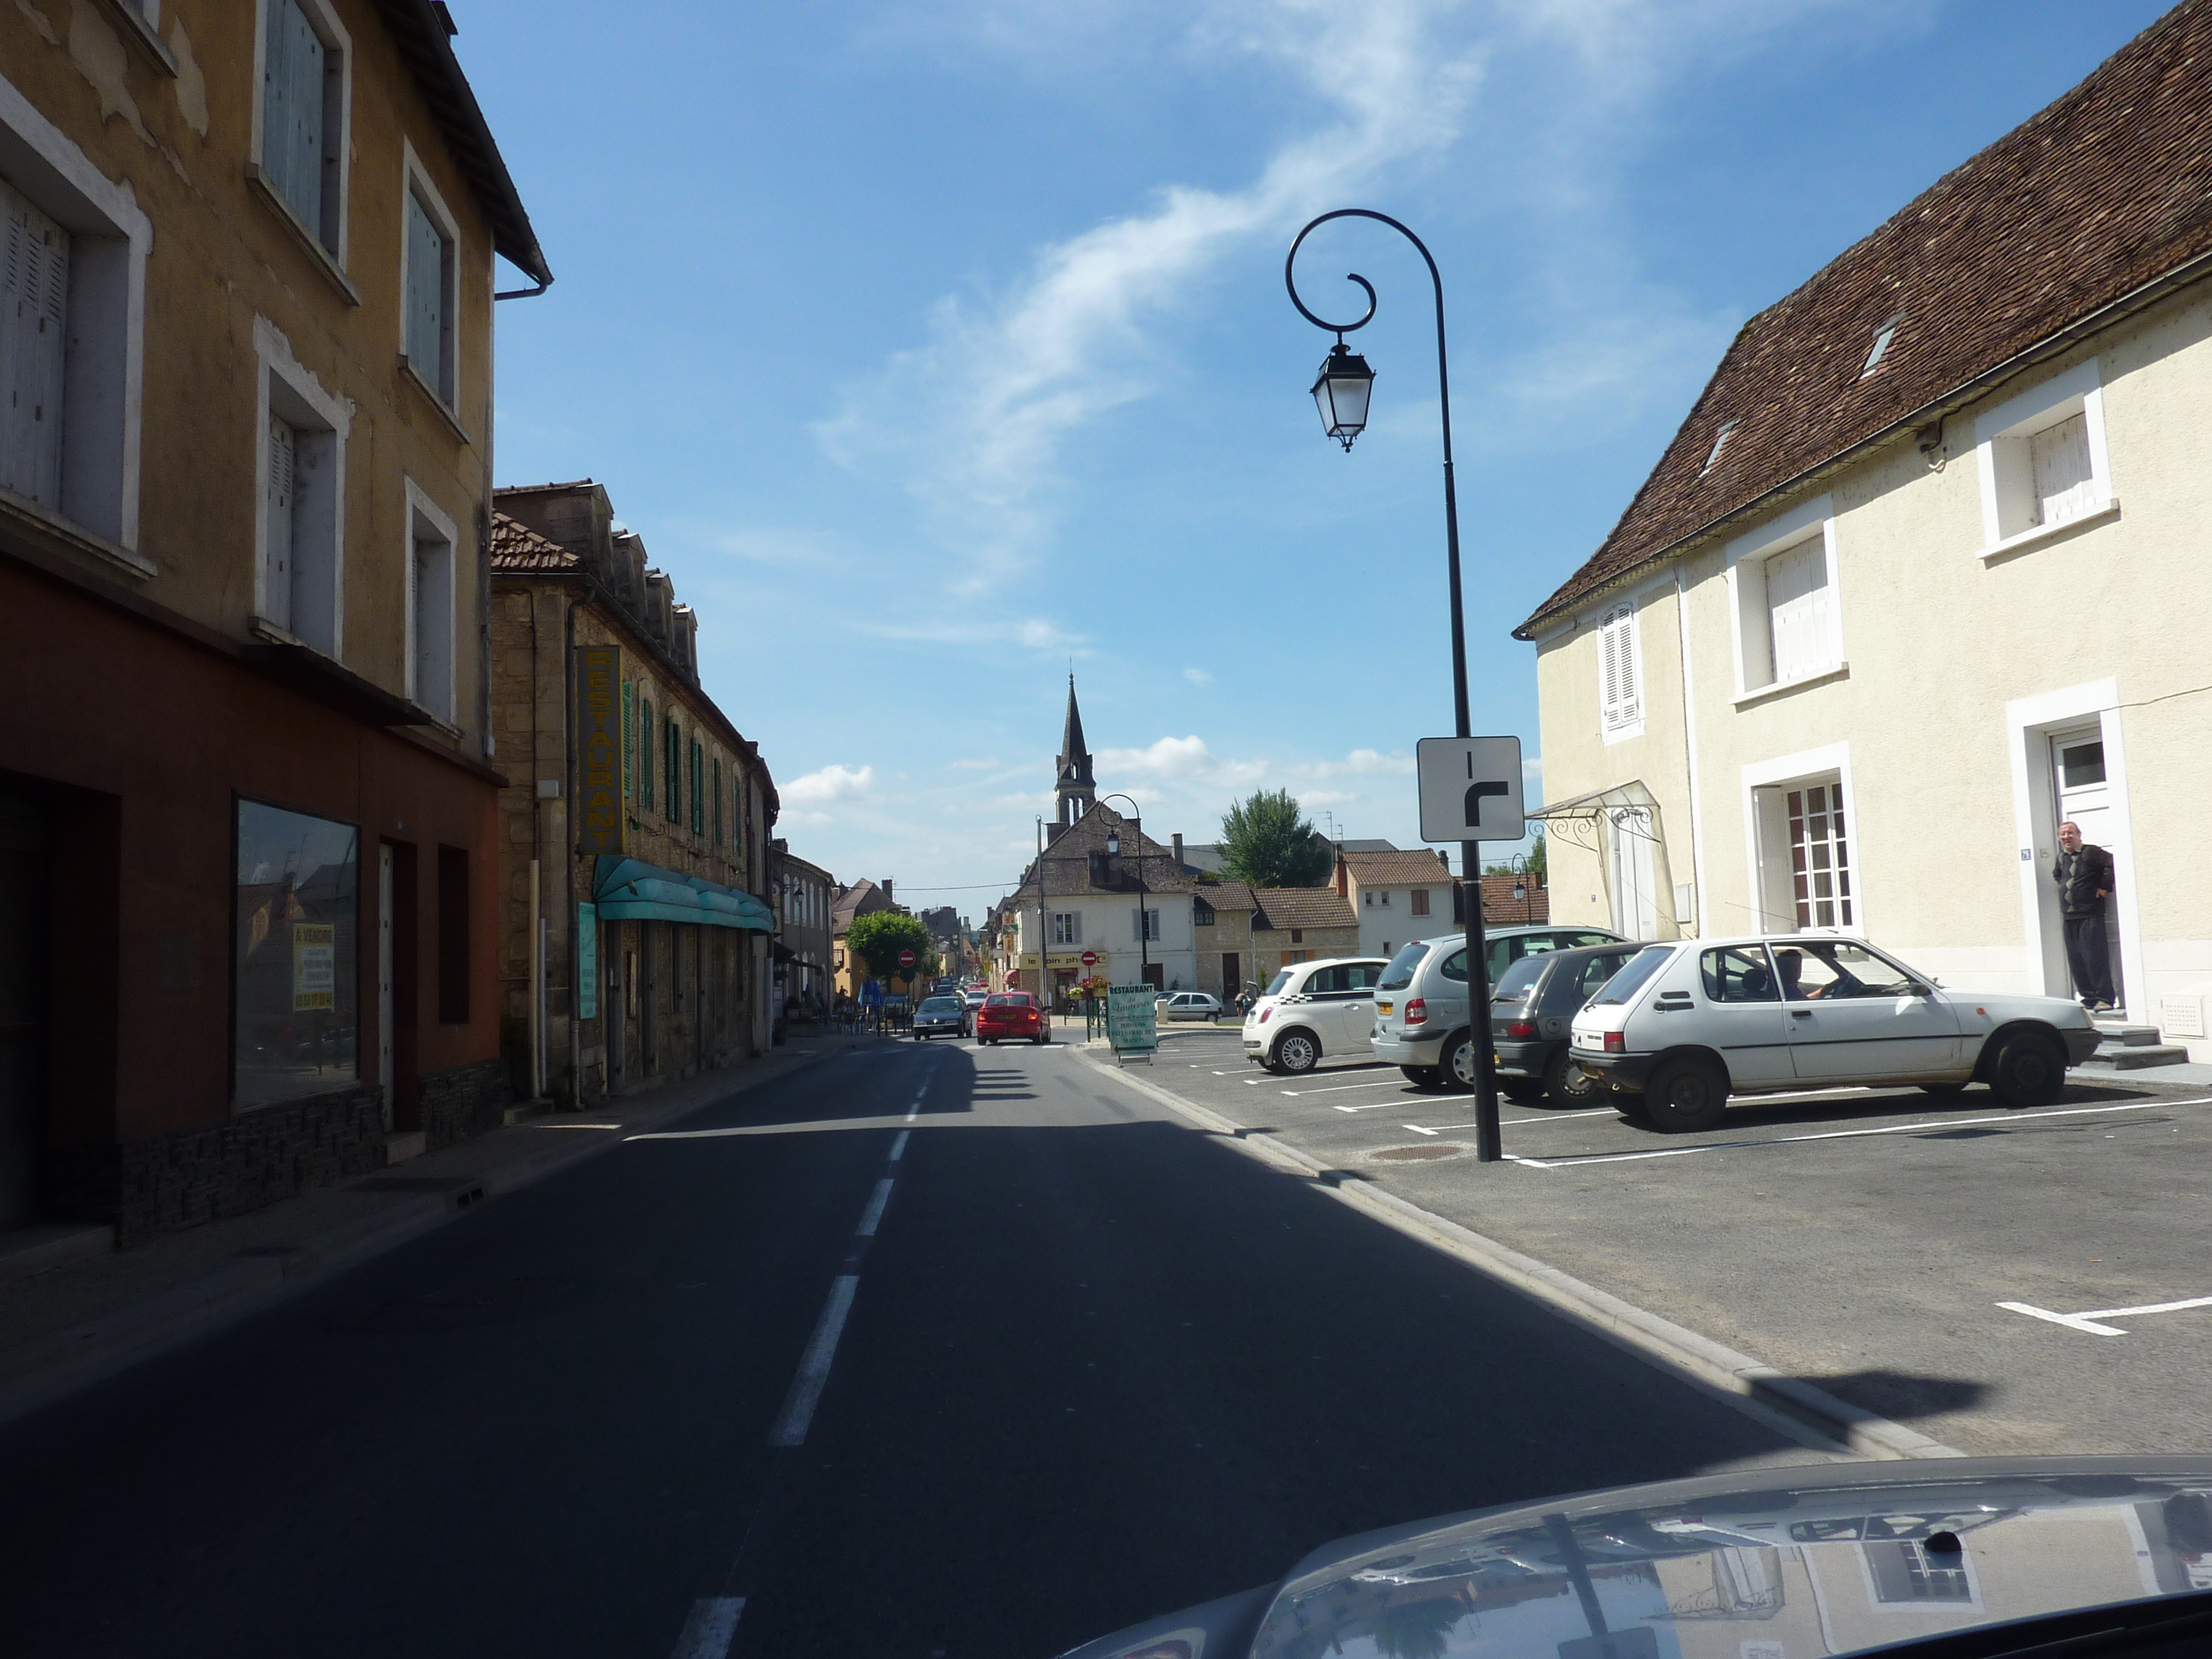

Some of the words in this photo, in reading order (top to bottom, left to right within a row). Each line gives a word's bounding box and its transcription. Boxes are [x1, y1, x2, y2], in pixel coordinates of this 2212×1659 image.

[586, 651, 615, 848] RESTAURANT
[304, 928, 332, 943] VENDRE
[1109, 985, 1153, 994] RESTAURANT
